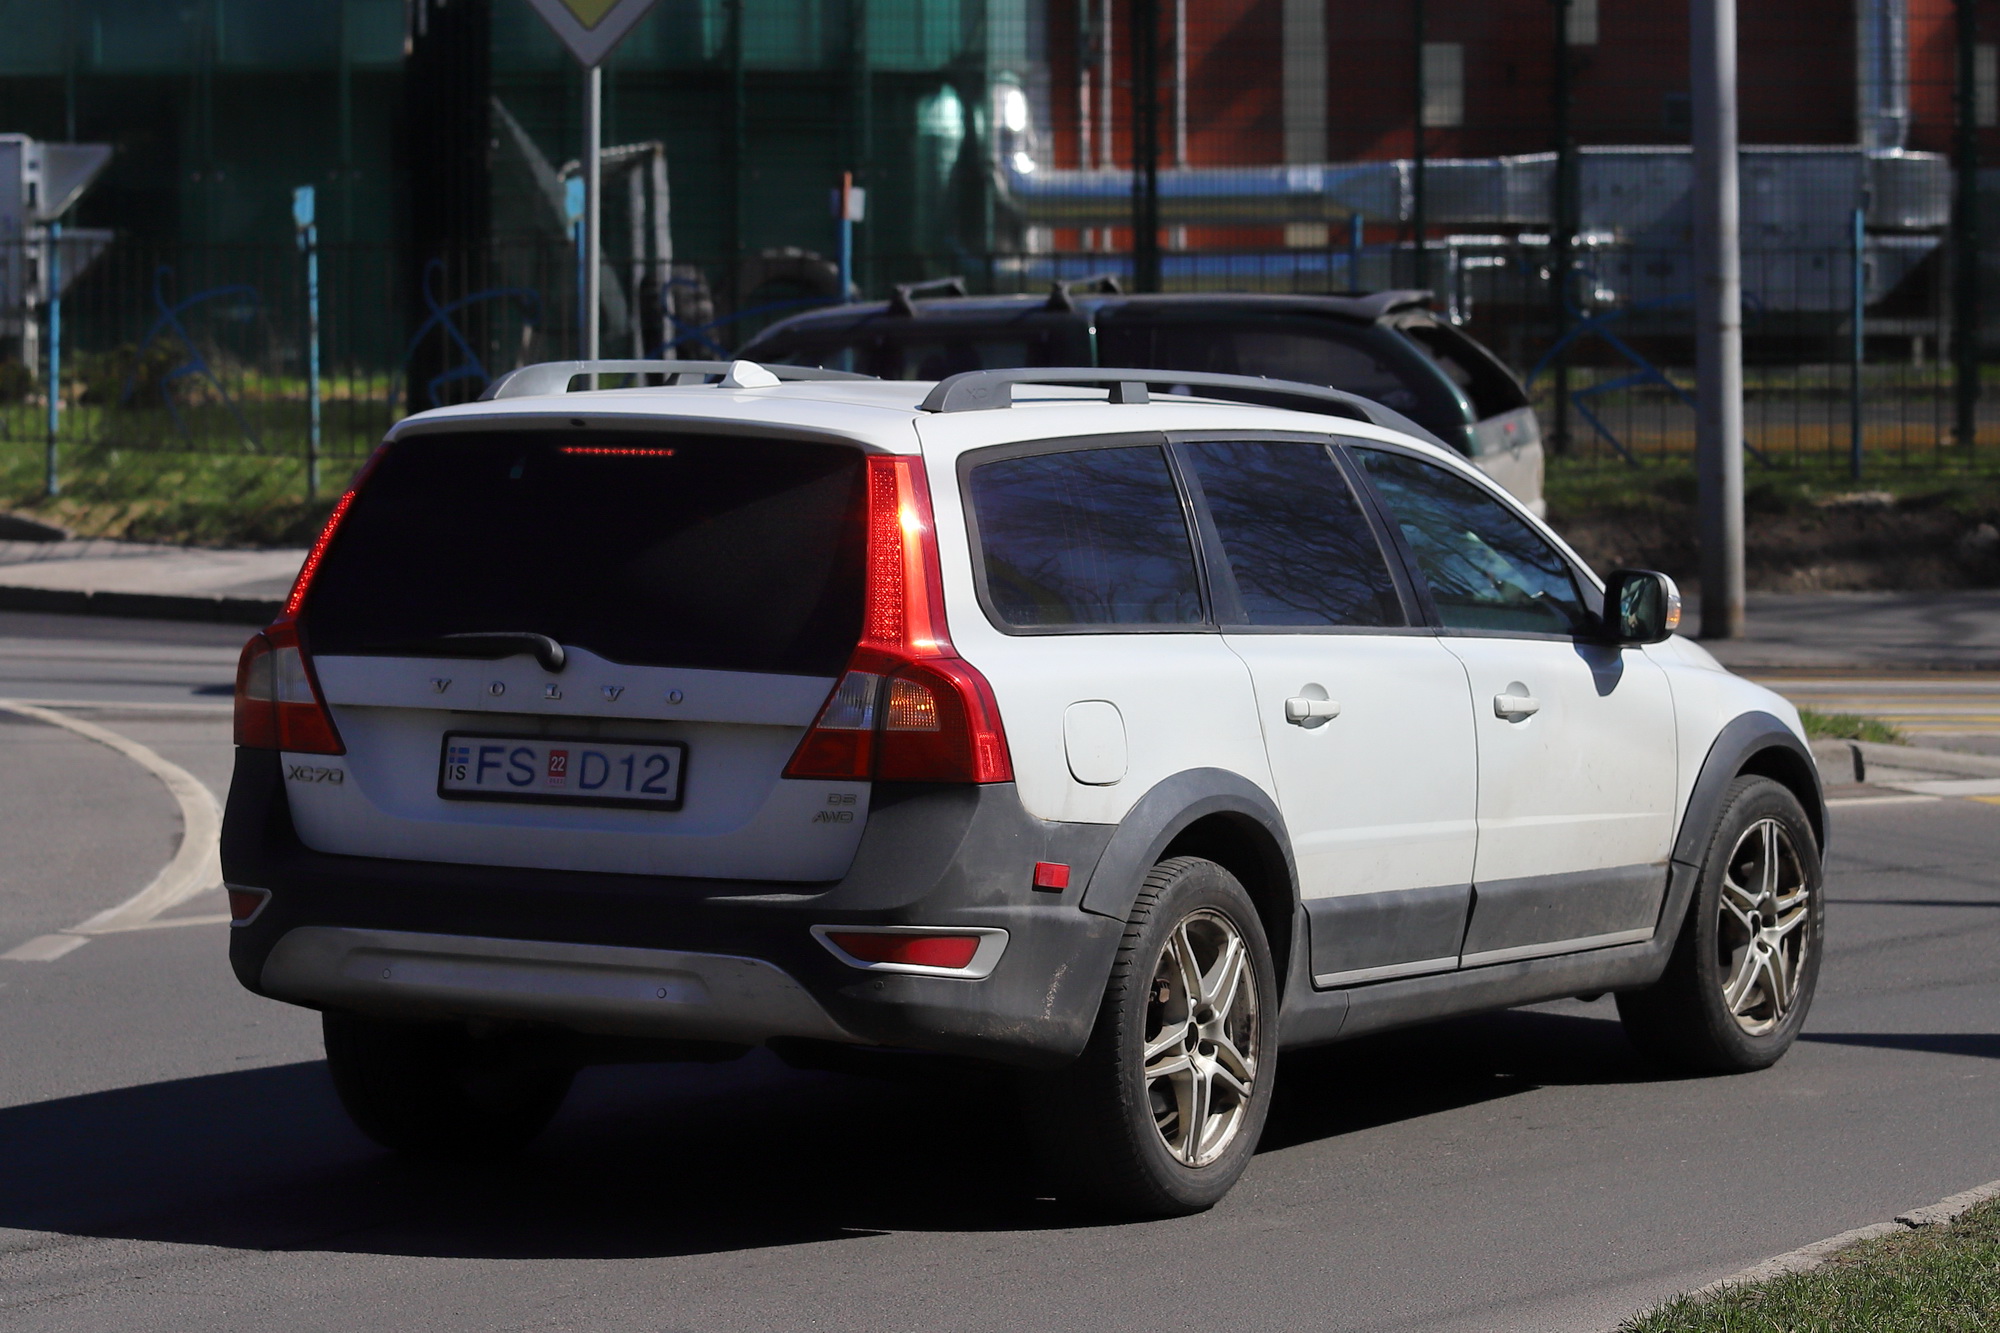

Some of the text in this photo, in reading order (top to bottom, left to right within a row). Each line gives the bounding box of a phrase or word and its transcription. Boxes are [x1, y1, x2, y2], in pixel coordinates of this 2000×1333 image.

[430, 677, 684, 705] VOLVO
[448, 765, 466, 780] IS
[476, 746, 670, 794] FS D12
[550, 756, 565, 771] 22
[288, 764, 344, 785] XC70
[812, 810, 853, 823] AWD
